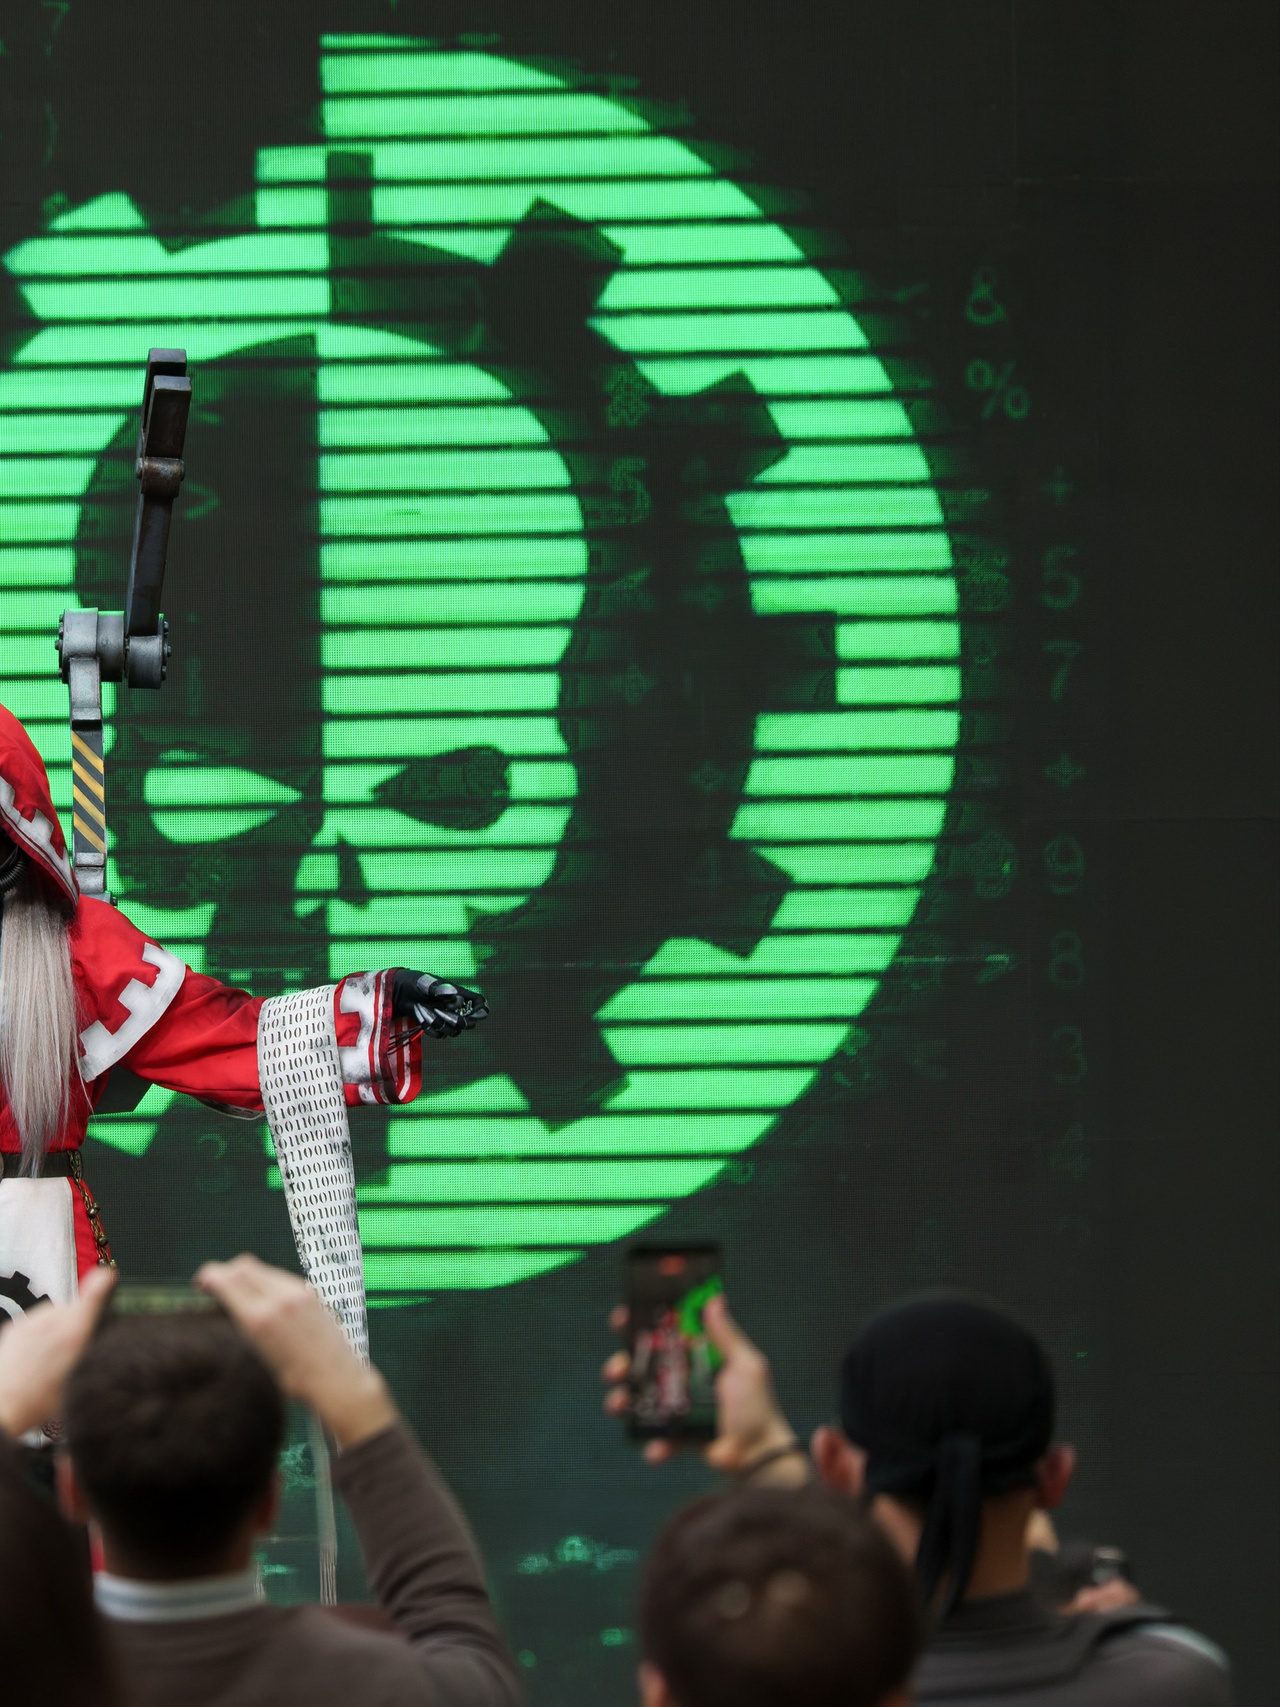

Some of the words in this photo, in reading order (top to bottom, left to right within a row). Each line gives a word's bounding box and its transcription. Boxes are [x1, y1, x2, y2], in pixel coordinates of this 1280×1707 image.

[964, 359, 1031, 421] %
[1041, 545, 1081, 609] 5
[1042, 640, 1083, 702] 7
